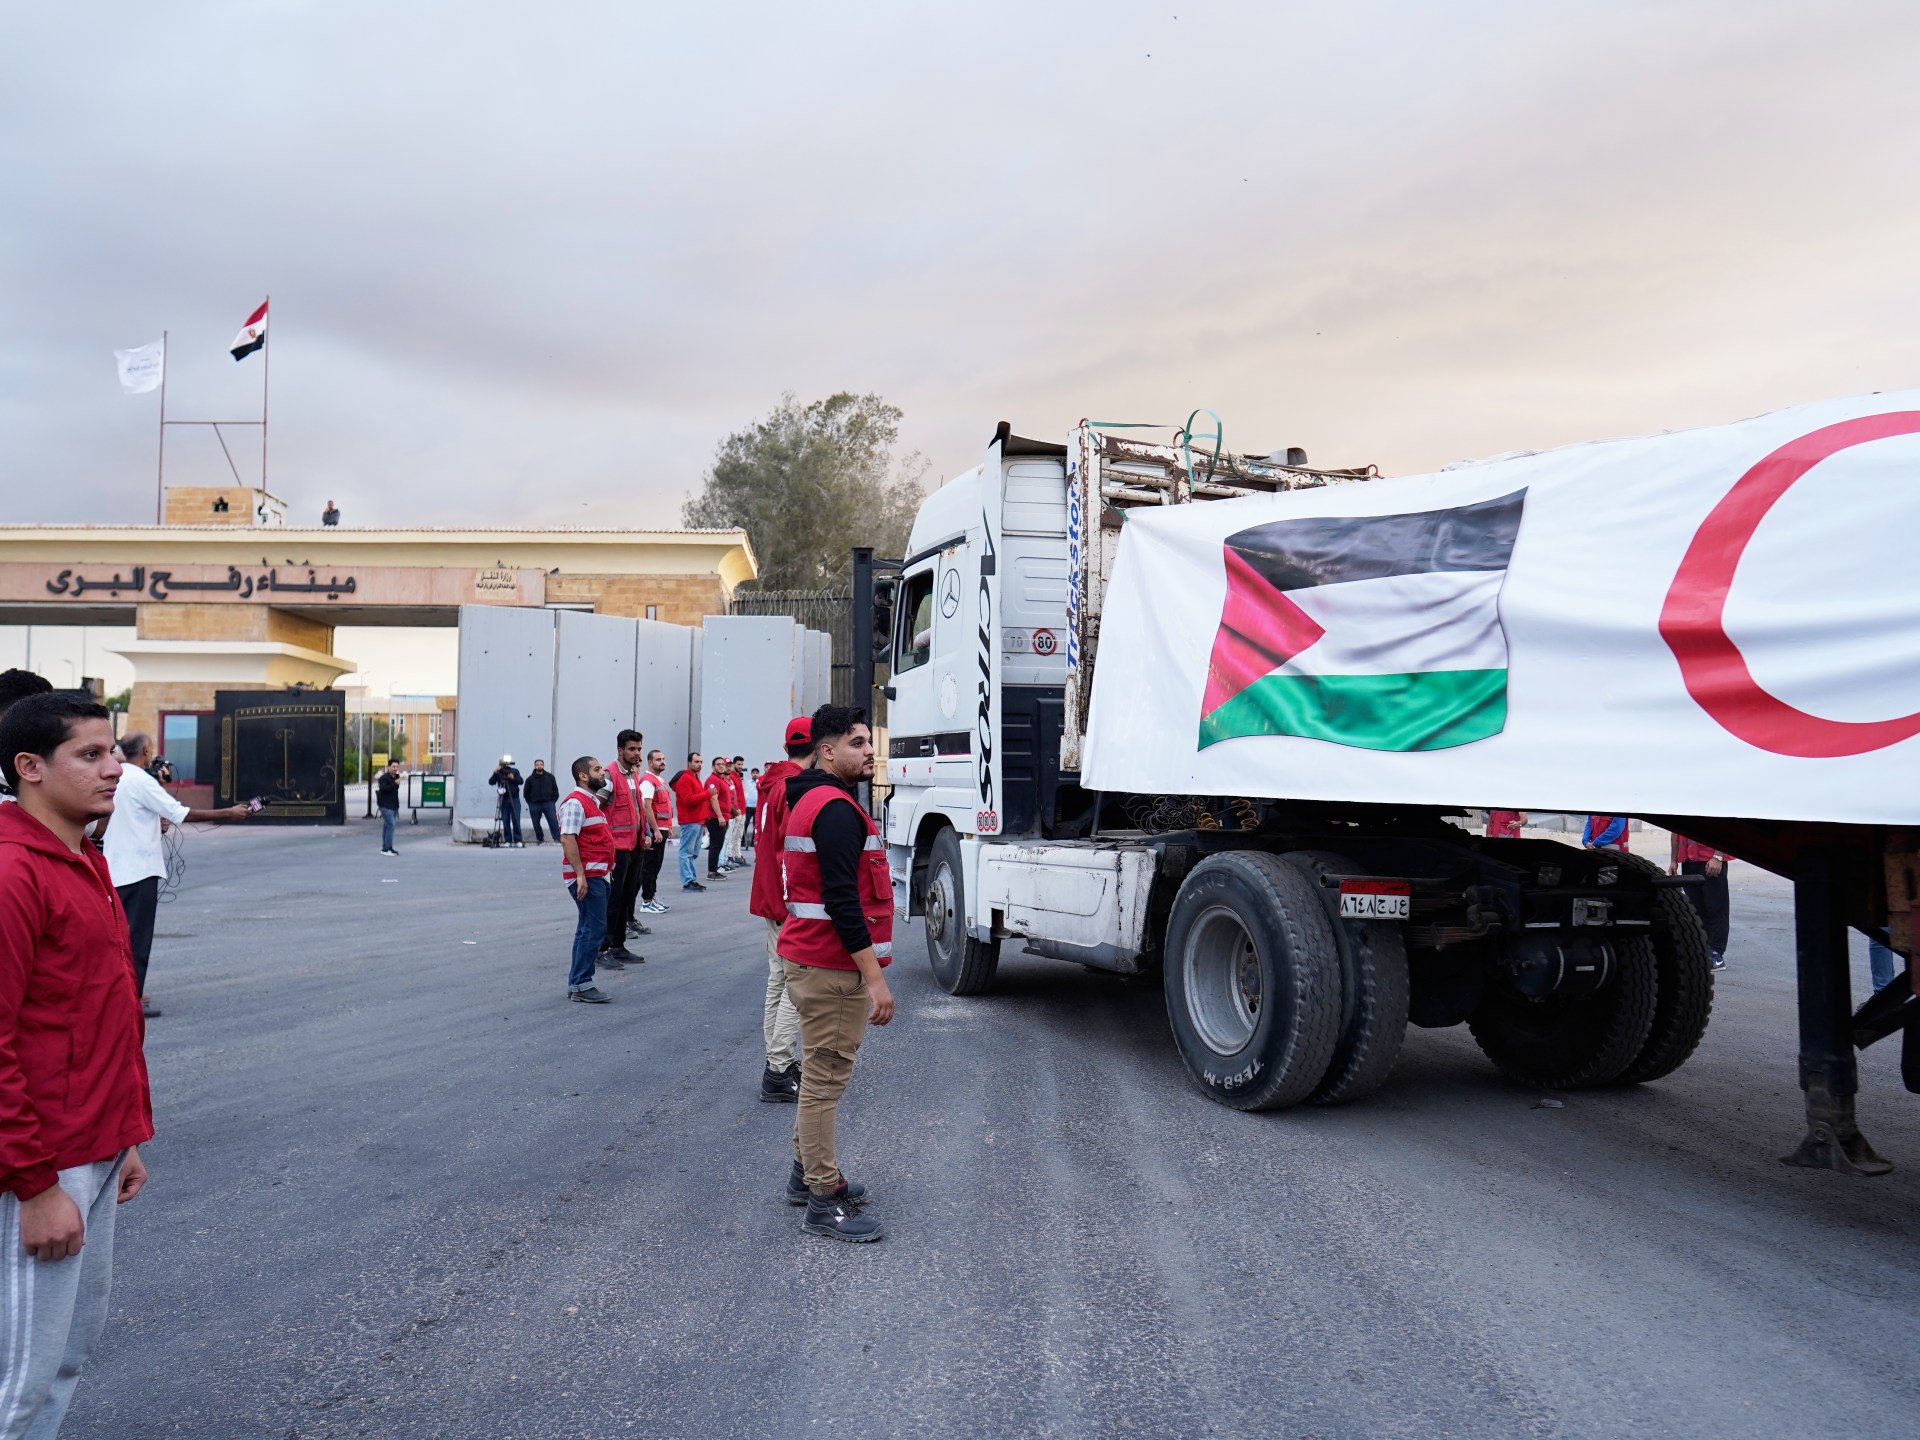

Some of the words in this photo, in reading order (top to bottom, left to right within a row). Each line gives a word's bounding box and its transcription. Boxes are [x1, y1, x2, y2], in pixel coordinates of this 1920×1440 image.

[149, 565, 253, 600] رفح
[256, 567, 356, 600] ميناء
[978, 505, 996, 812] ACTROS
[1010, 636, 1023, 648] 70
[1037, 636, 1053, 650] 80
